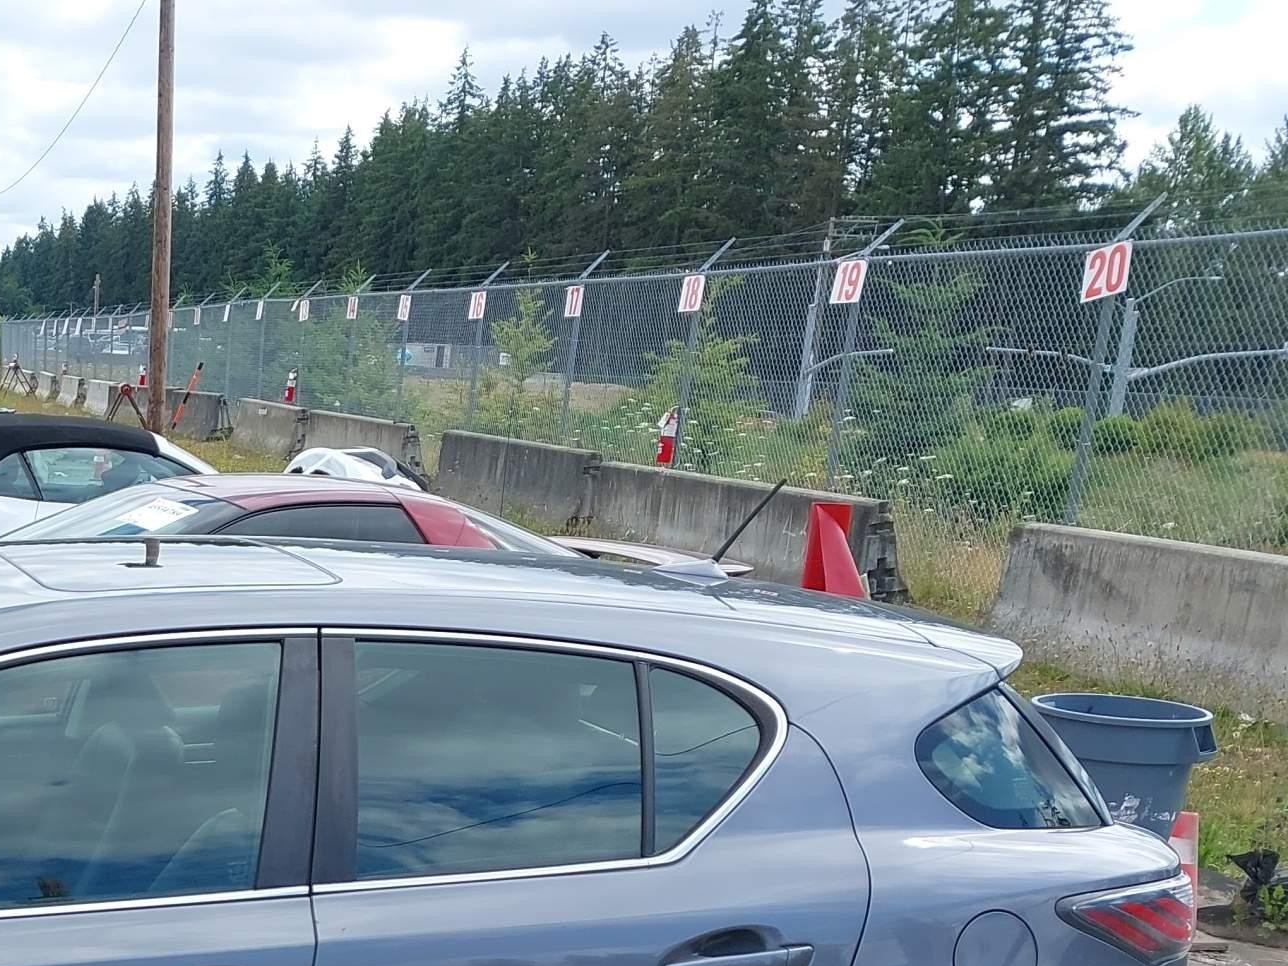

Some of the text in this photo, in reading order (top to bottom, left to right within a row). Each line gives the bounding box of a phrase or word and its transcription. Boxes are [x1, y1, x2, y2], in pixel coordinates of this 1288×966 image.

[837, 261, 863, 301] 19
[1085, 244, 1129, 299] 20
[471, 293, 485, 318] 16
[567, 287, 582, 315] 17
[682, 276, 700, 311] 18
